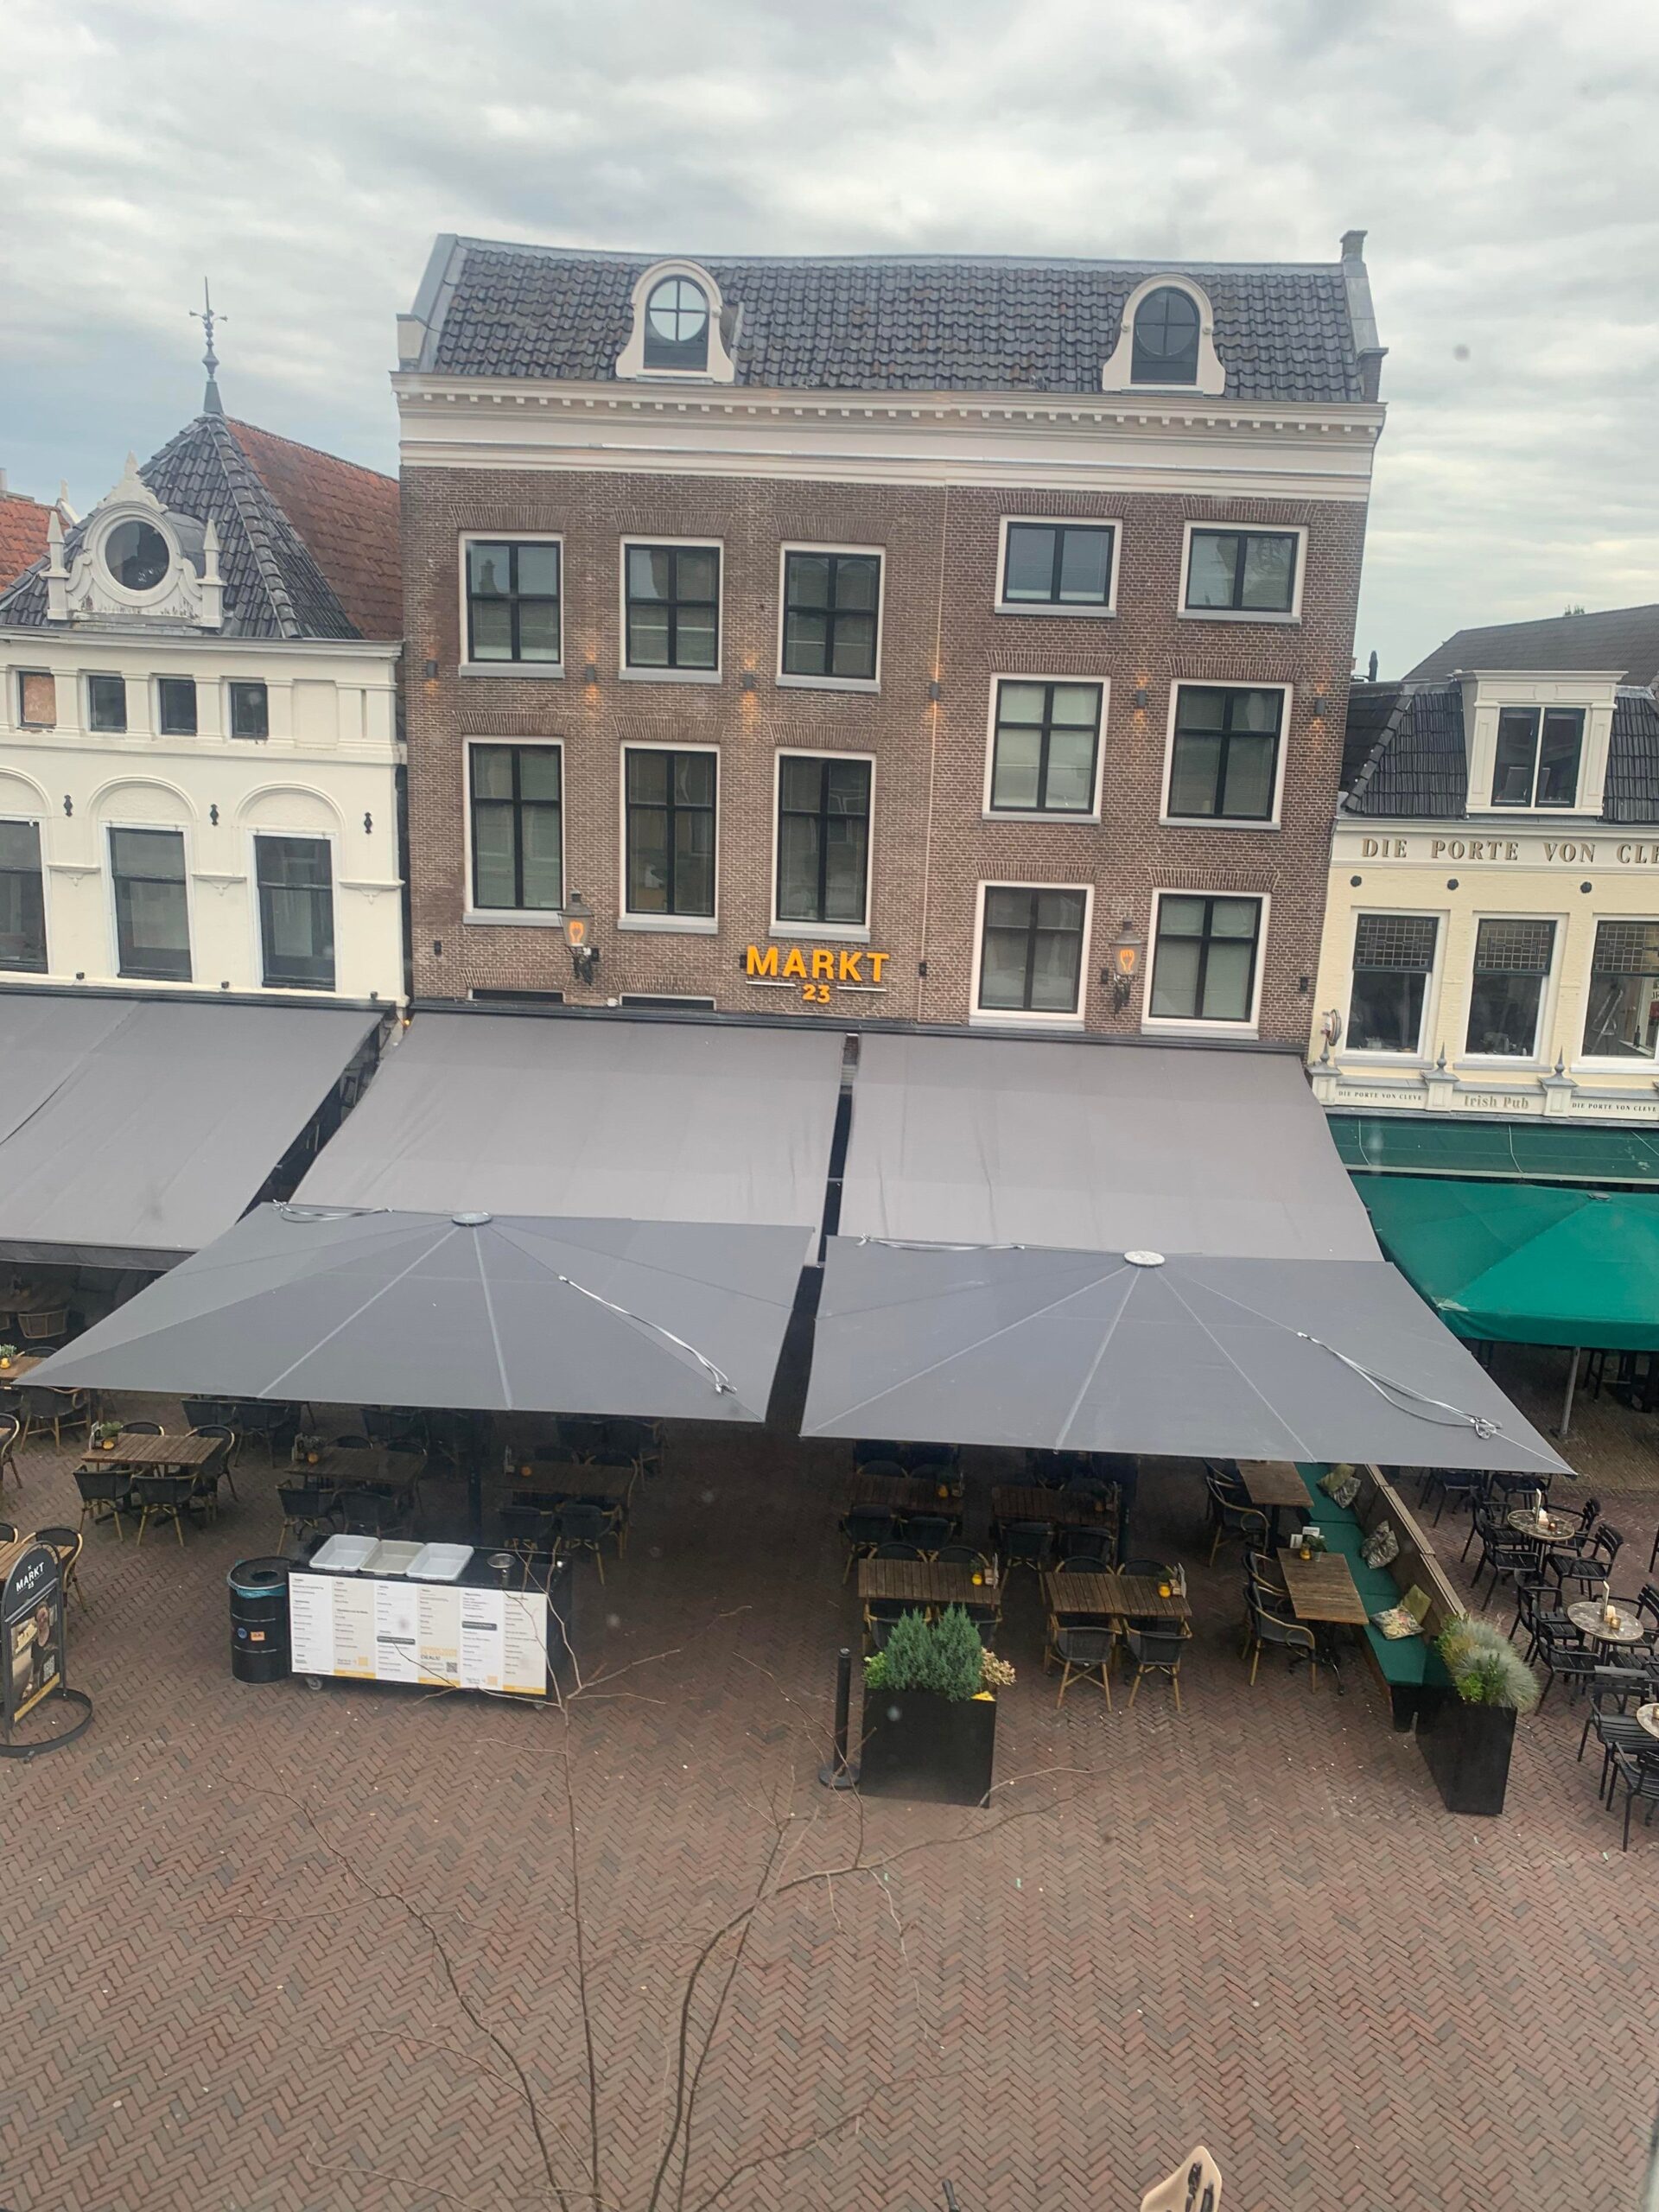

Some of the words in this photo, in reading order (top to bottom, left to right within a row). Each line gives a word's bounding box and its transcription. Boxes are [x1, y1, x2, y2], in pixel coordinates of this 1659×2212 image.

[1361, 837, 1408, 858] DIE
[1430, 839, 1519, 861] PORTE
[1543, 842, 1596, 863] VON
[746, 944, 890, 982] MARKT
[801, 983, 830, 1004] 23
[1464, 1095, 1497, 1107] Irish
[1503, 1096, 1529, 1109] Pub
[16, 1561, 45, 1592] MARKT
